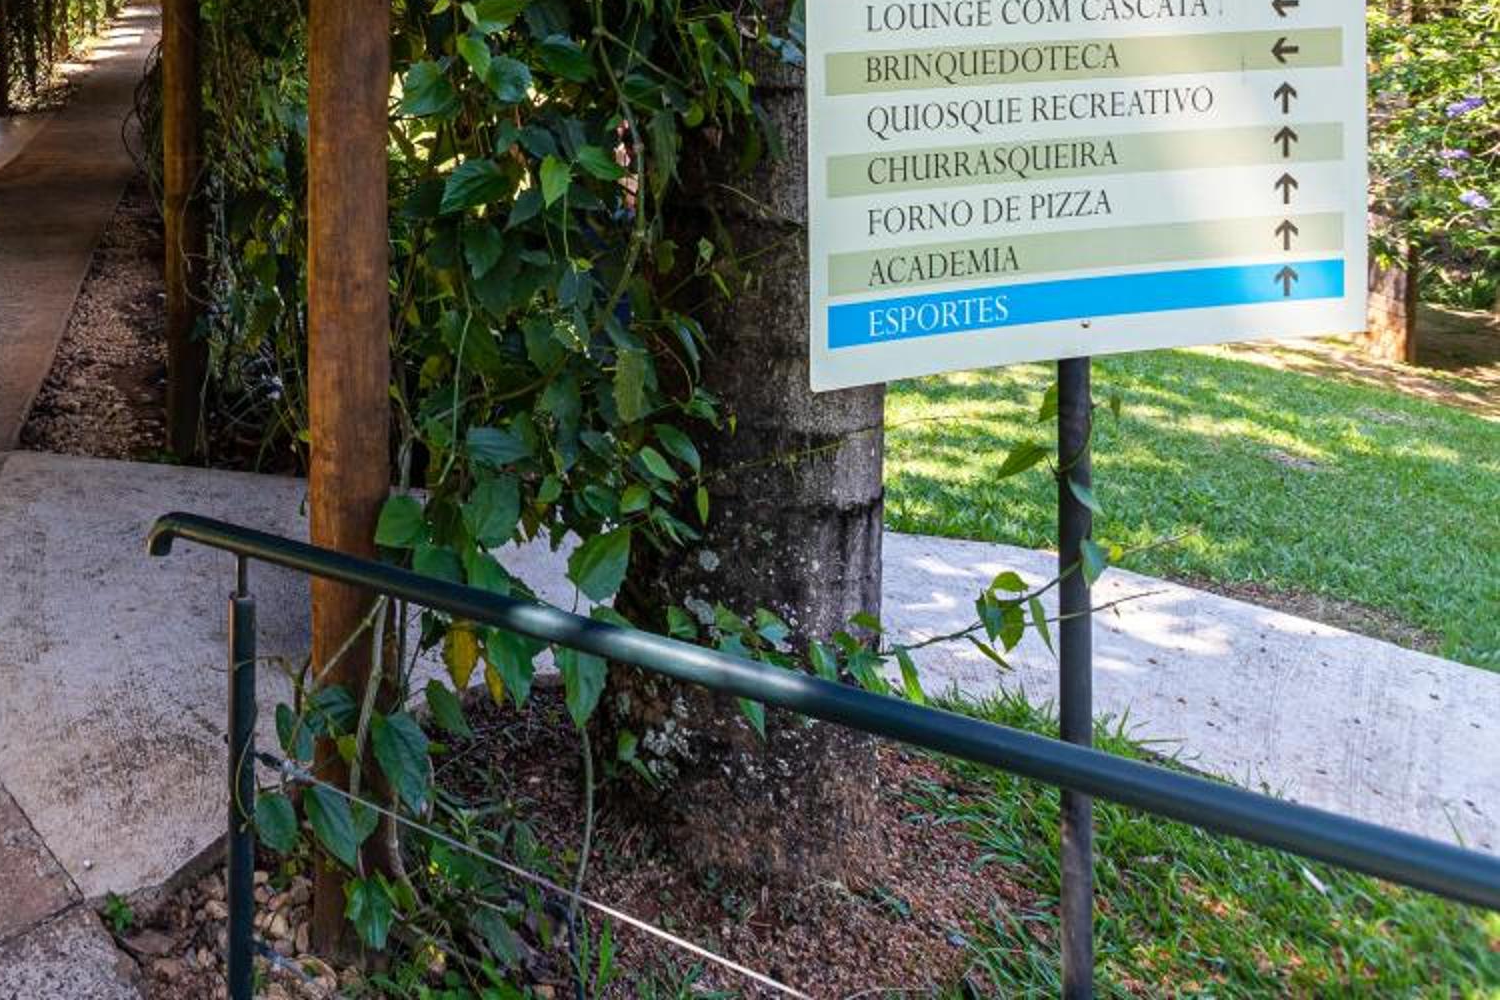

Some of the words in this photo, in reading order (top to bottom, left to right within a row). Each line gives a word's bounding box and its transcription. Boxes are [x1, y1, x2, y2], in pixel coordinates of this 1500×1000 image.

[866, 0, 991, 33] LOUNGE
[866, 42, 1120, 84] BRINQUEDOTECA
[866, 97, 1023, 139] QUIOSQUE
[1031, 85, 1214, 123] RECREATIVO
[866, 140, 1118, 185] CHURRASQUEIRA
[867, 200, 973, 237] FORNO
[982, 198, 1022, 225] DE
[1030, 189, 1113, 220] PIZZA
[868, 245, 1021, 288] ACADEMIA
[868, 295, 1010, 338] ESPORTES
